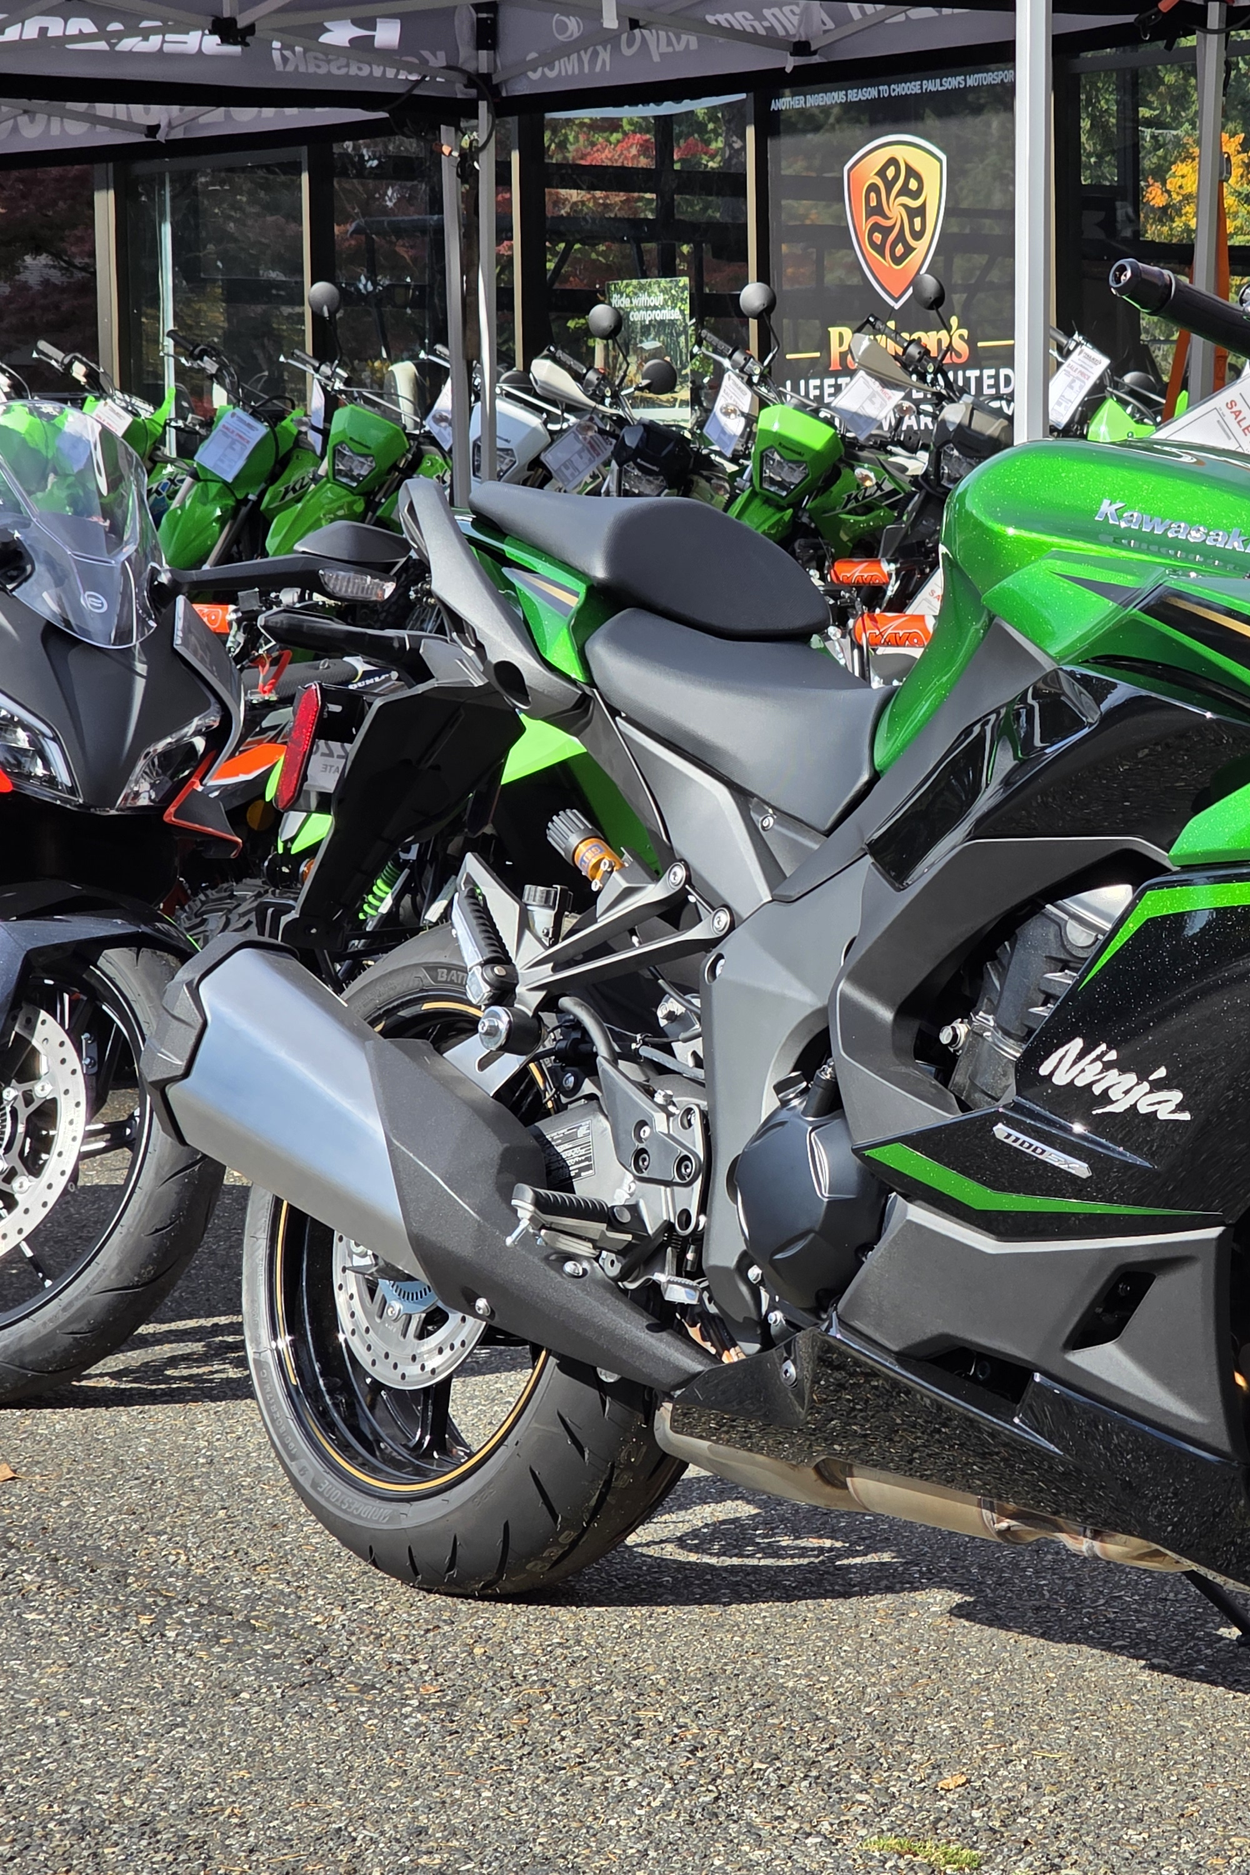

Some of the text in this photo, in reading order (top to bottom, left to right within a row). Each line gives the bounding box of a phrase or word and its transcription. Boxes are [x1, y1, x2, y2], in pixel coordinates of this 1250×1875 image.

[770, 95, 805, 111] ANOTHER
[806, 91, 846, 107] INGENIOUS
[847, 87, 878, 102] REASON
[878, 85, 888, 98] TO
[890, 81, 921, 96] CHOOSE
[922, 76, 965, 94] PAULSON'S
[611, 291, 664, 307] Ride without
[843, 476, 890, 510] KLX
[1038, 1036, 1192, 1121] Ninja
[317, 1479, 394, 1524] BRIDGESTONE
